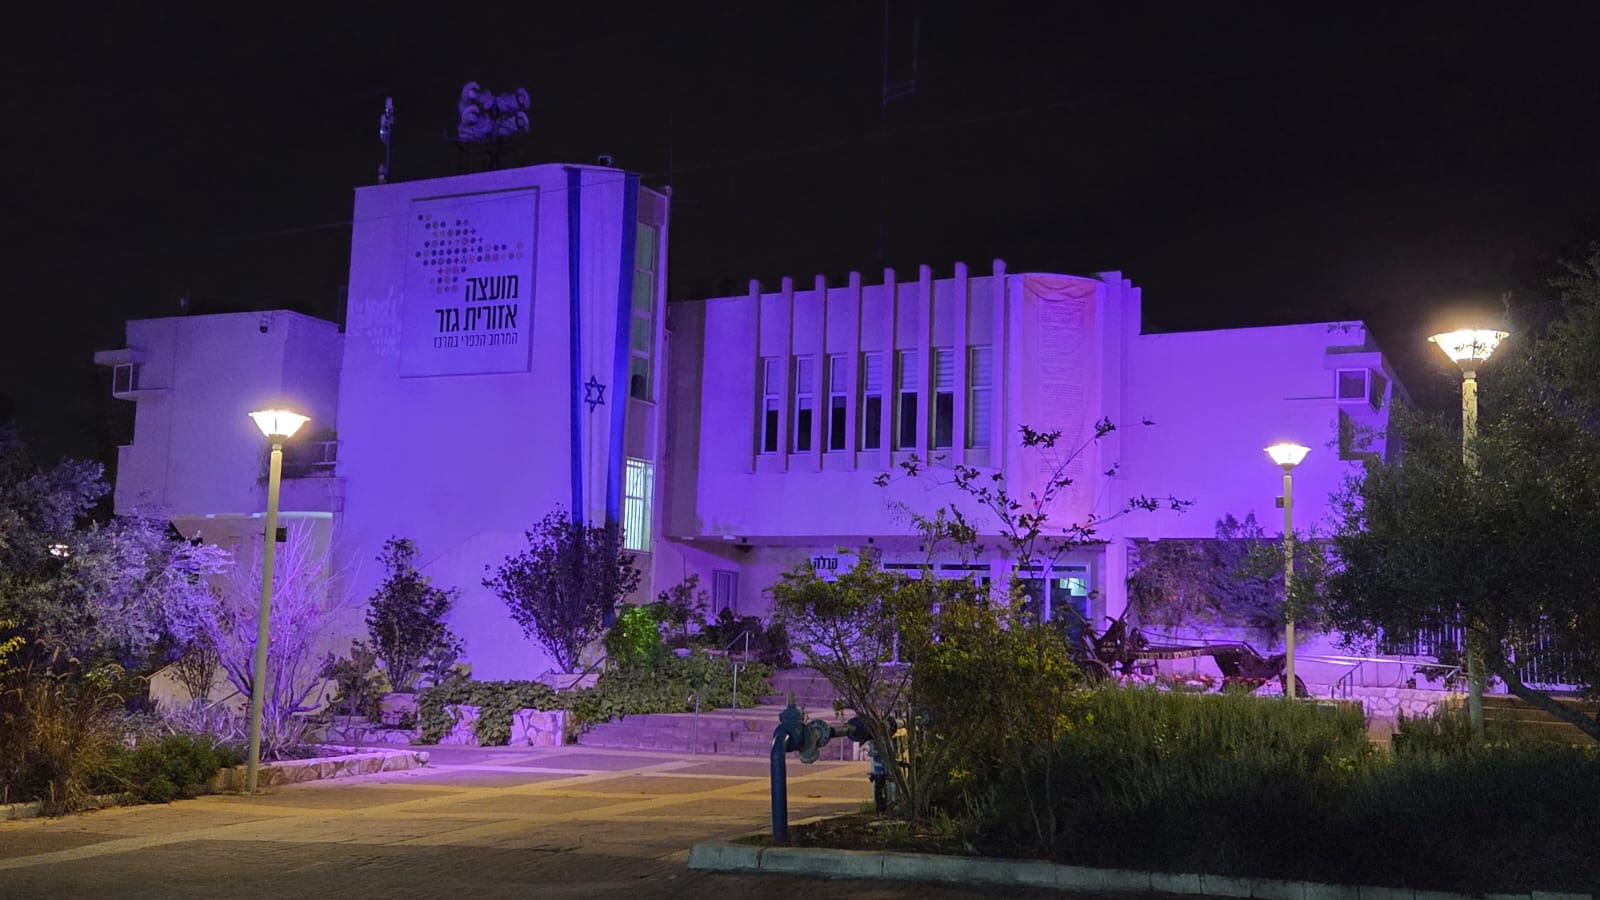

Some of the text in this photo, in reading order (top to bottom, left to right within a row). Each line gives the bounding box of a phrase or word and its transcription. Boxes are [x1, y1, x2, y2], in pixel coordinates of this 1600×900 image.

[465, 275, 518, 302] מועצה
[435, 304, 517, 333] אזורית גזר
[433, 333, 518, 349] המרחב הכפרי במרכז
[813, 556, 838, 571] קבלה
